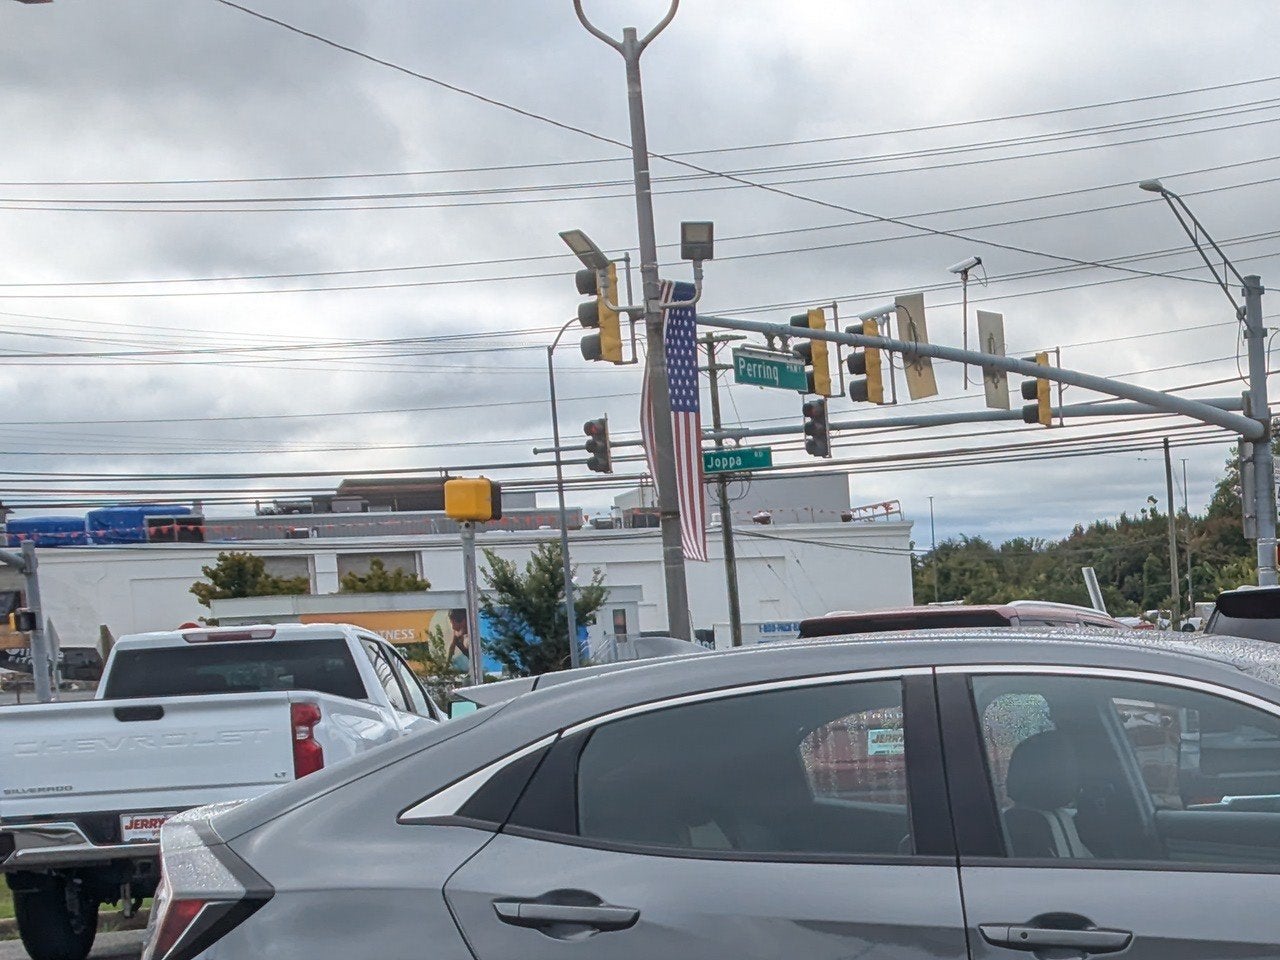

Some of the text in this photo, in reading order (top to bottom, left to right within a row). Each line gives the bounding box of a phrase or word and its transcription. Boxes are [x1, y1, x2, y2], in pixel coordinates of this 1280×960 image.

[738, 357, 779, 386] Perring
[707, 456, 742, 469] Joppa
[377, 628, 416, 640] TNESS
[13, 727, 271, 758] CHEVROLET
[274, 771, 287, 779] LT
[3, 784, 74, 796] SILVERADO
[124, 817, 168, 830] JERRY
